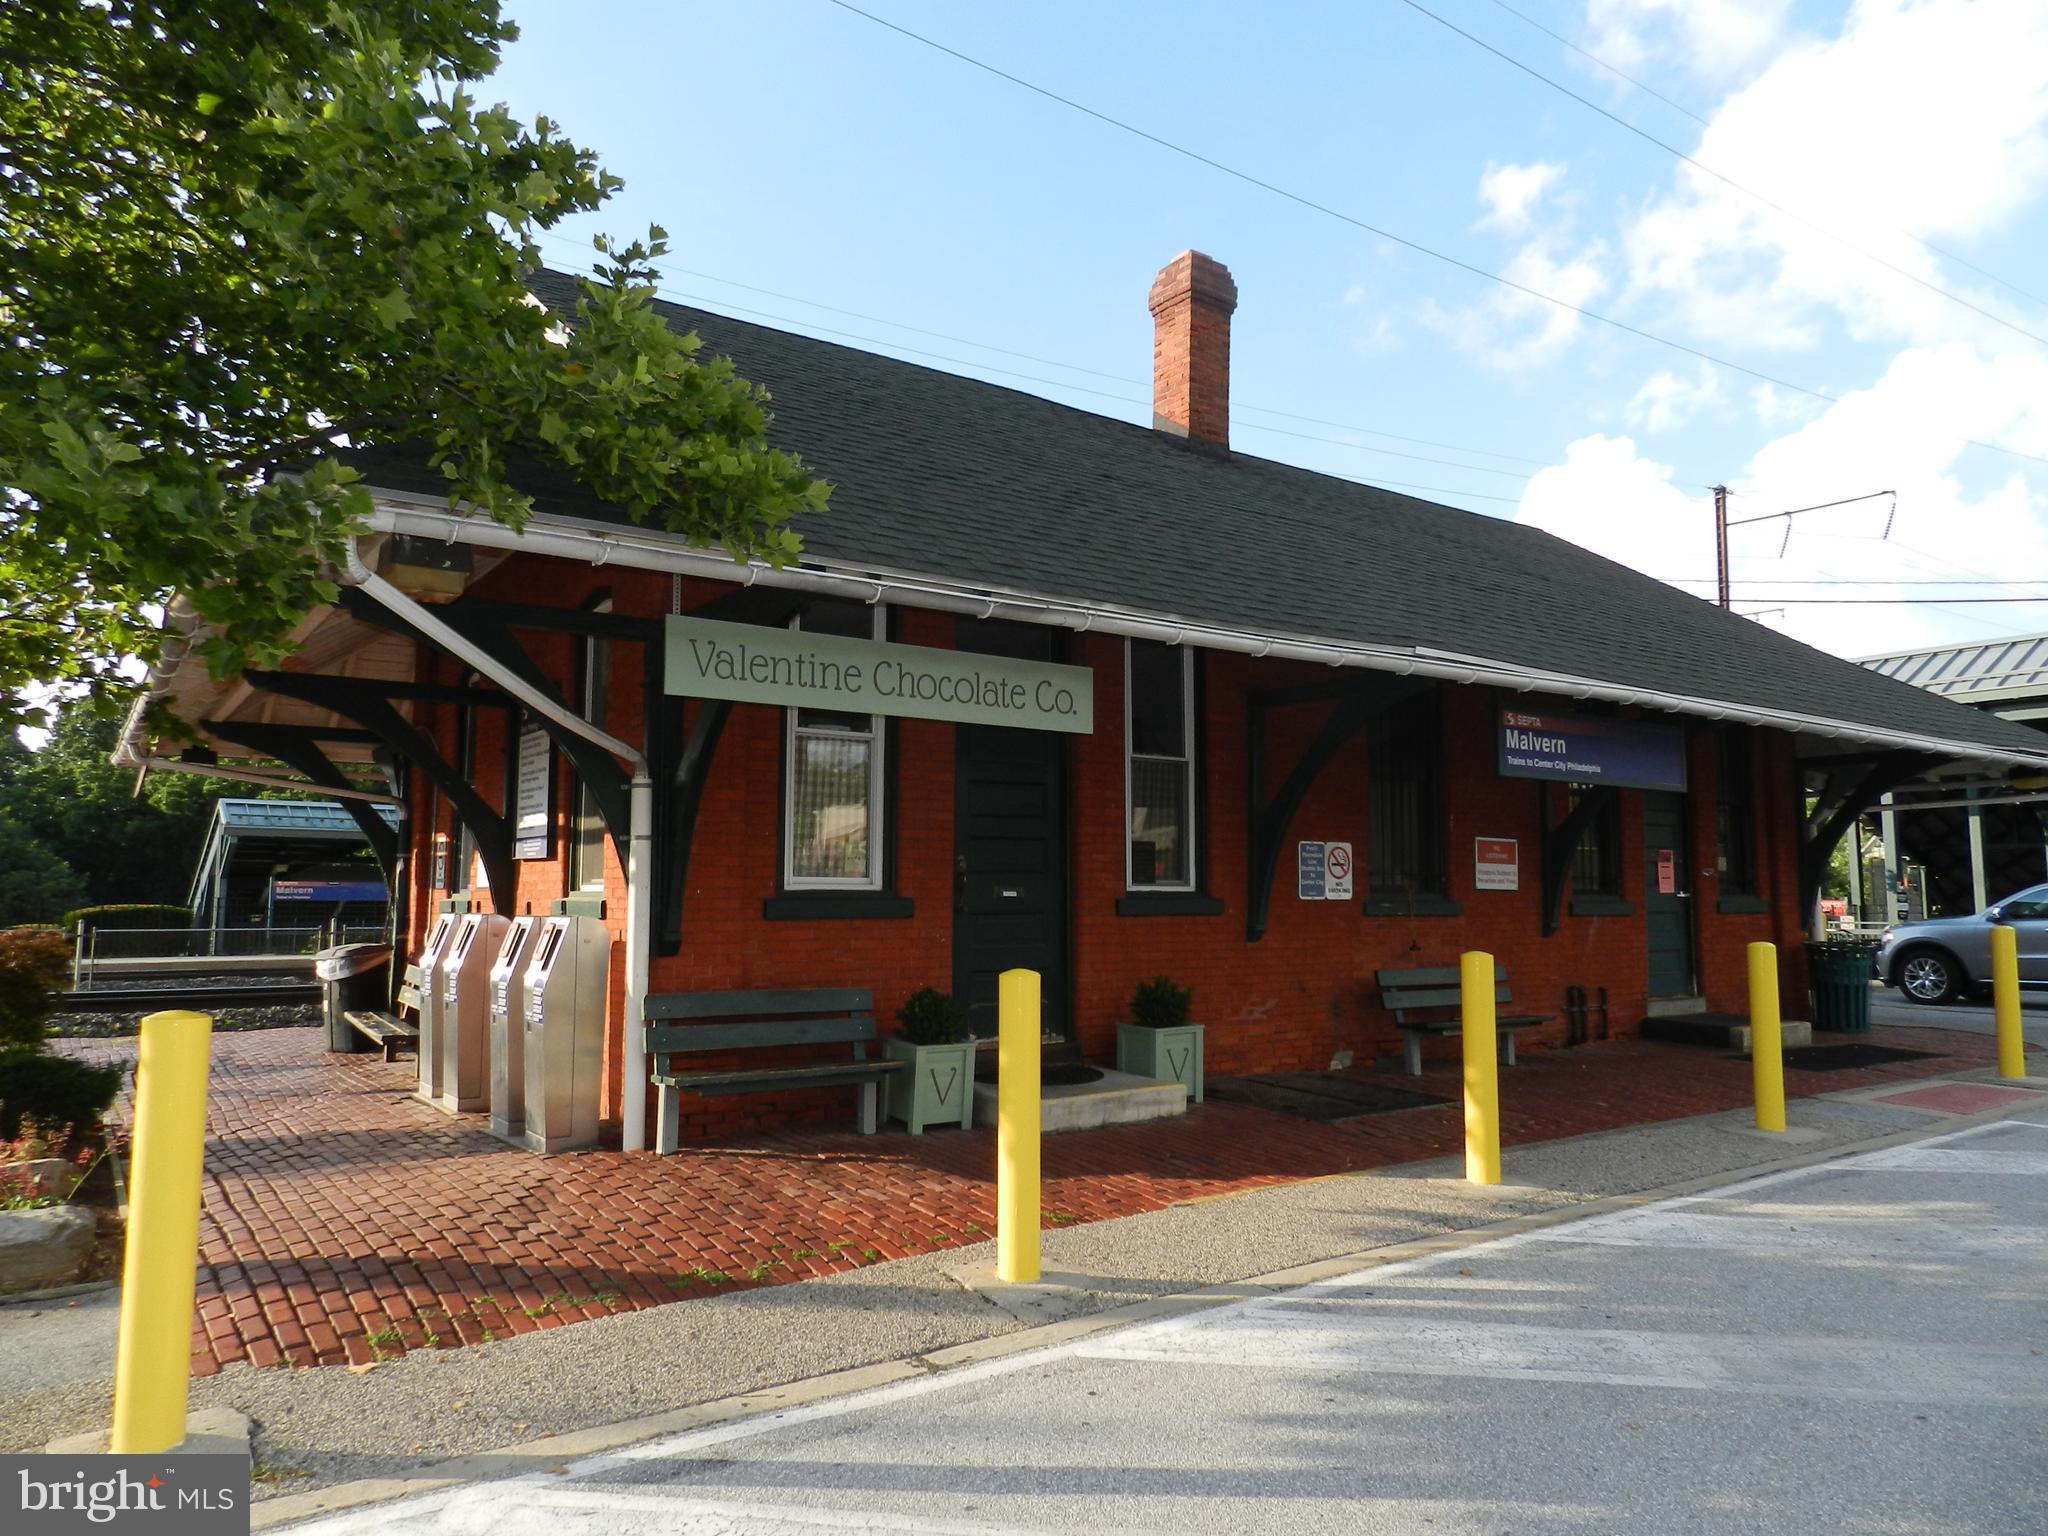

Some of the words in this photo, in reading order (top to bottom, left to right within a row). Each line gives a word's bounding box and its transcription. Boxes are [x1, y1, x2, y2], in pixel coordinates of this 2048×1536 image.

[689, 638, 862, 692] Valentine
[873, 660, 1026, 710] Chocolate
[1035, 680, 1078, 715] Co.
[1518, 716, 1541, 728] SEPTA
[1506, 730, 1566, 754] Malvern
[1508, 756, 1526, 766] Trains
[1534, 759, 1554, 769] Center
[1555, 760, 1566, 772] City
[1167, 1047, 1190, 1082] V
[930, 1067, 957, 1106] V
